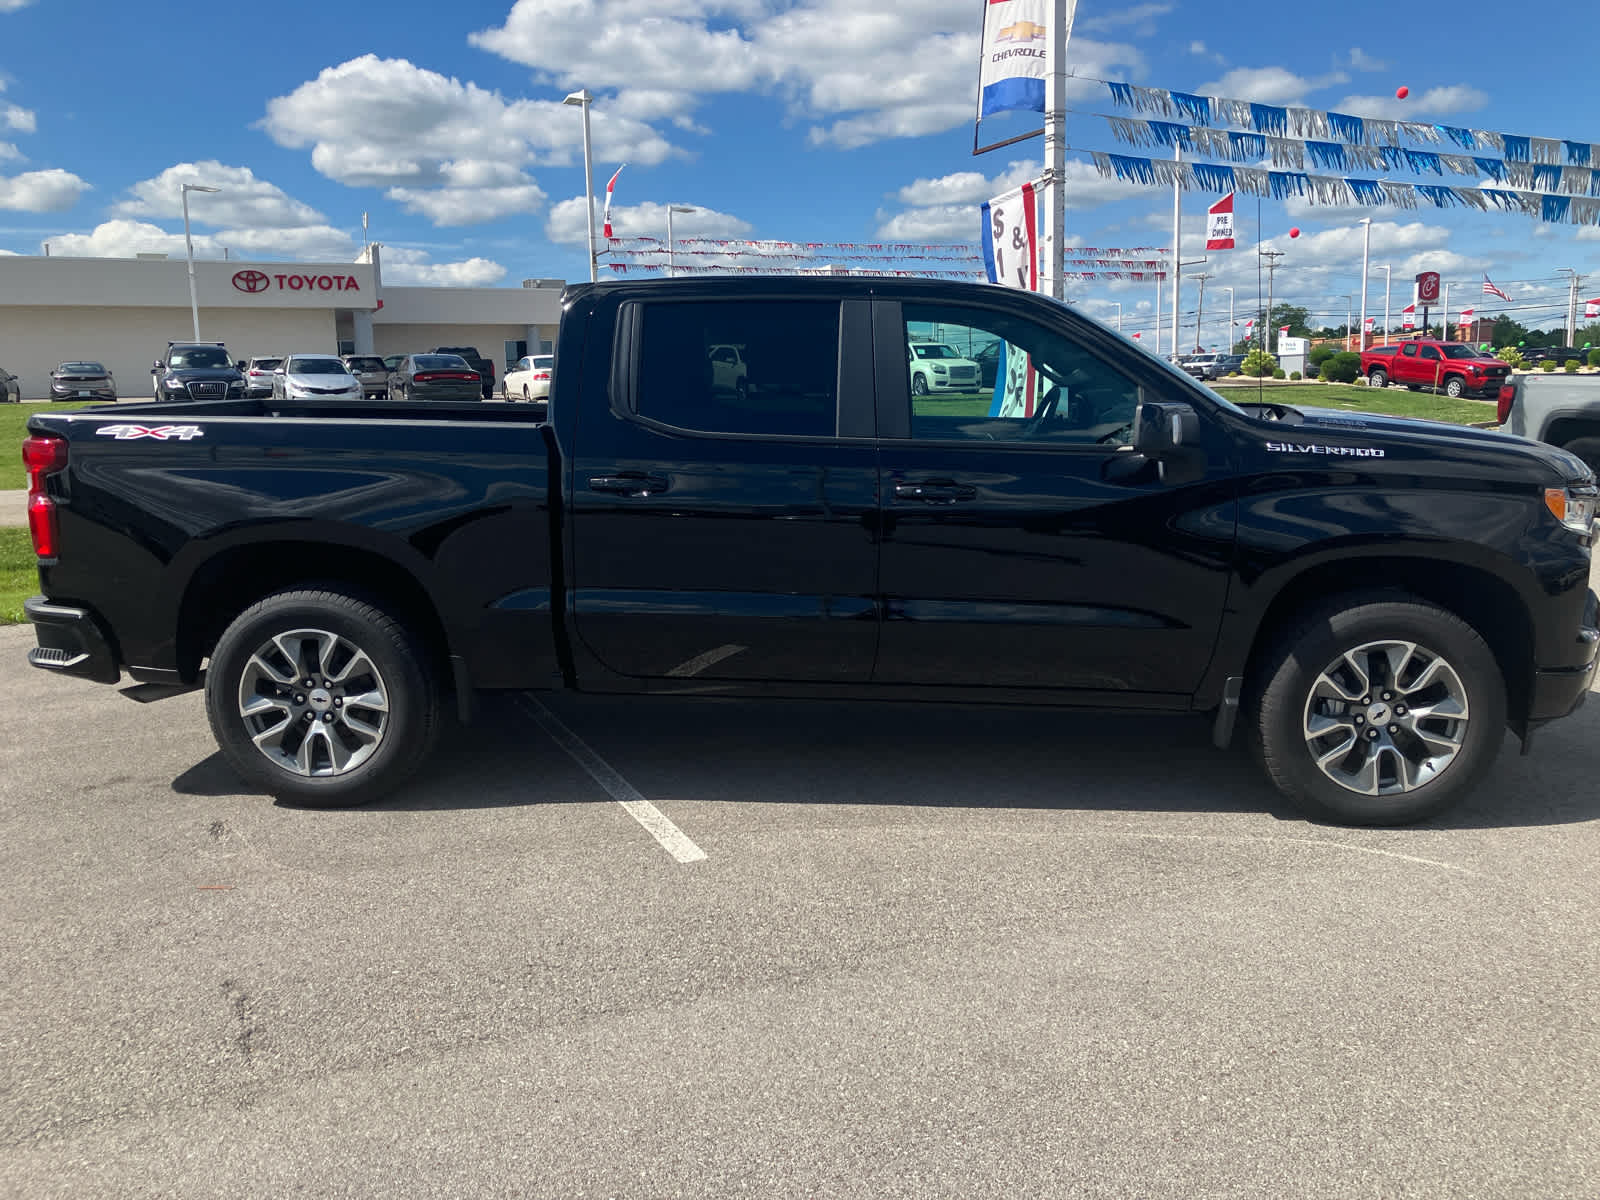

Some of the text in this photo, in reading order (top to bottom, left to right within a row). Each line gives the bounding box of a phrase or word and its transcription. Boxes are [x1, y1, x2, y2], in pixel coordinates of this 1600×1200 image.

[992, 47, 1046, 62] CHEVROLE
[1216, 216, 1228, 225] PRE
[274, 274, 360, 292] TOYOTA
[1265, 441, 1385, 458] SILVERADO
